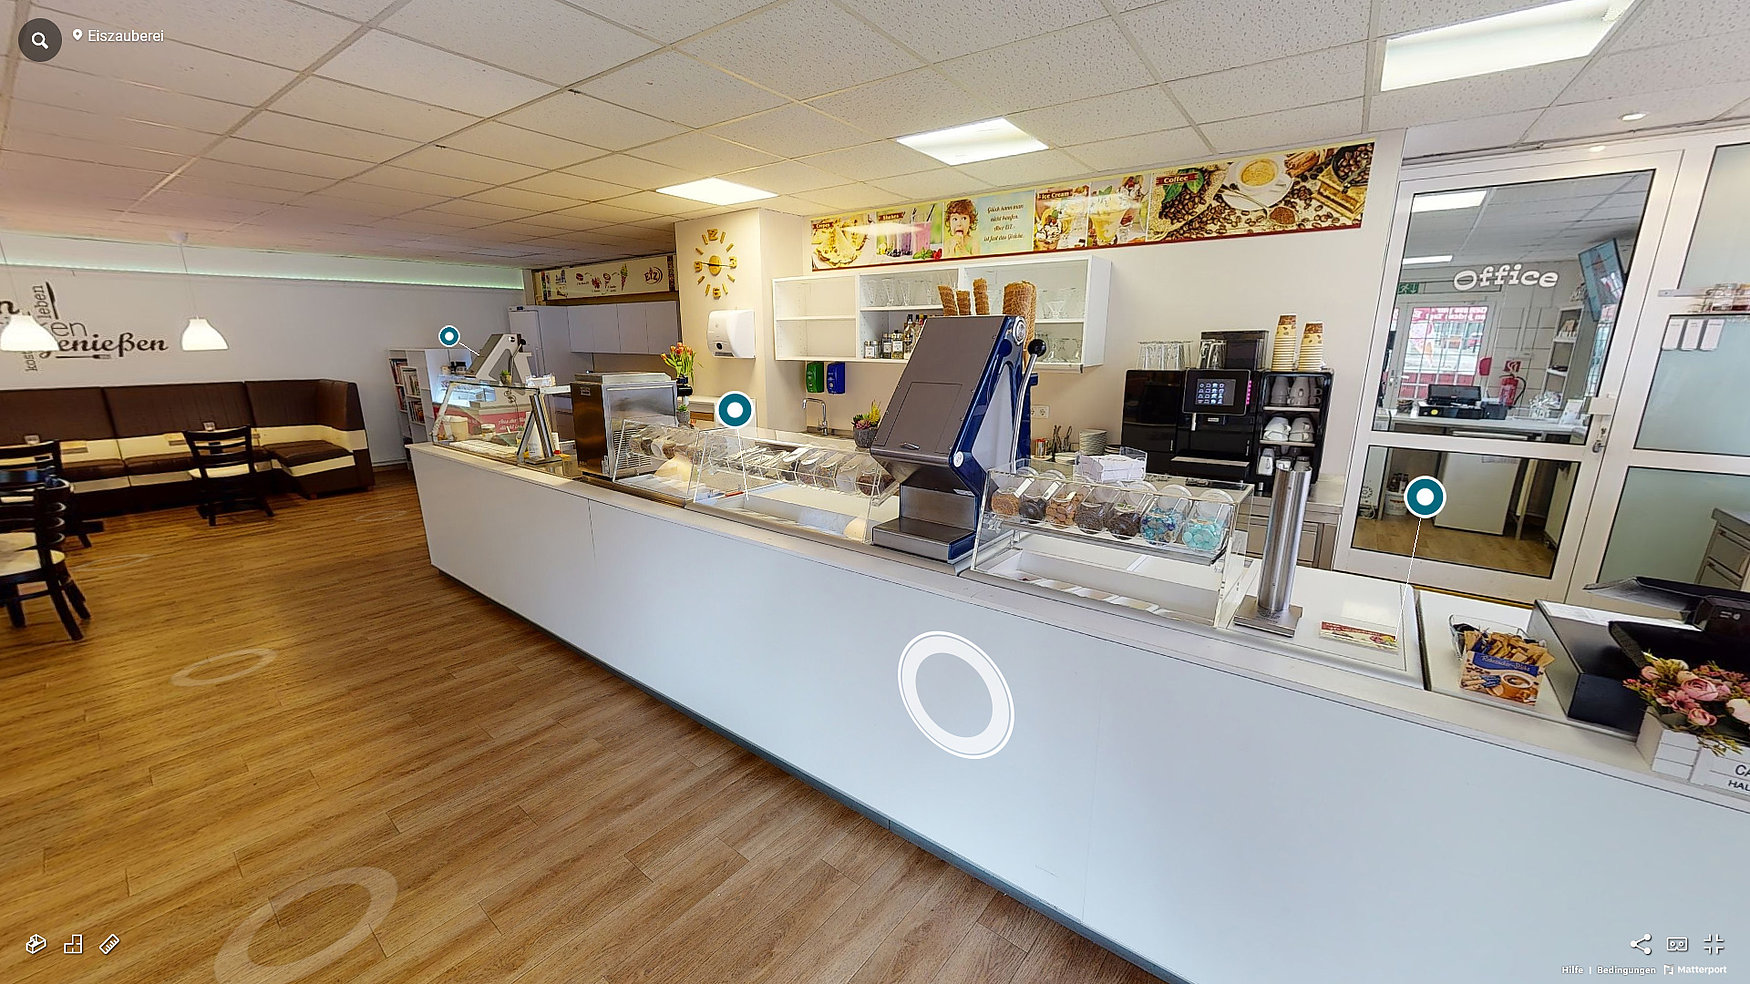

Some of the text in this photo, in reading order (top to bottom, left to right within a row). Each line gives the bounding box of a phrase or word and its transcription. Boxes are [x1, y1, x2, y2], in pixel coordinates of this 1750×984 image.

[1164, 175, 1188, 184] Coffee
[1051, 191, 1070, 199] Cream
[1453, 263, 1559, 291] Office
[32, 285, 51, 319] leben
